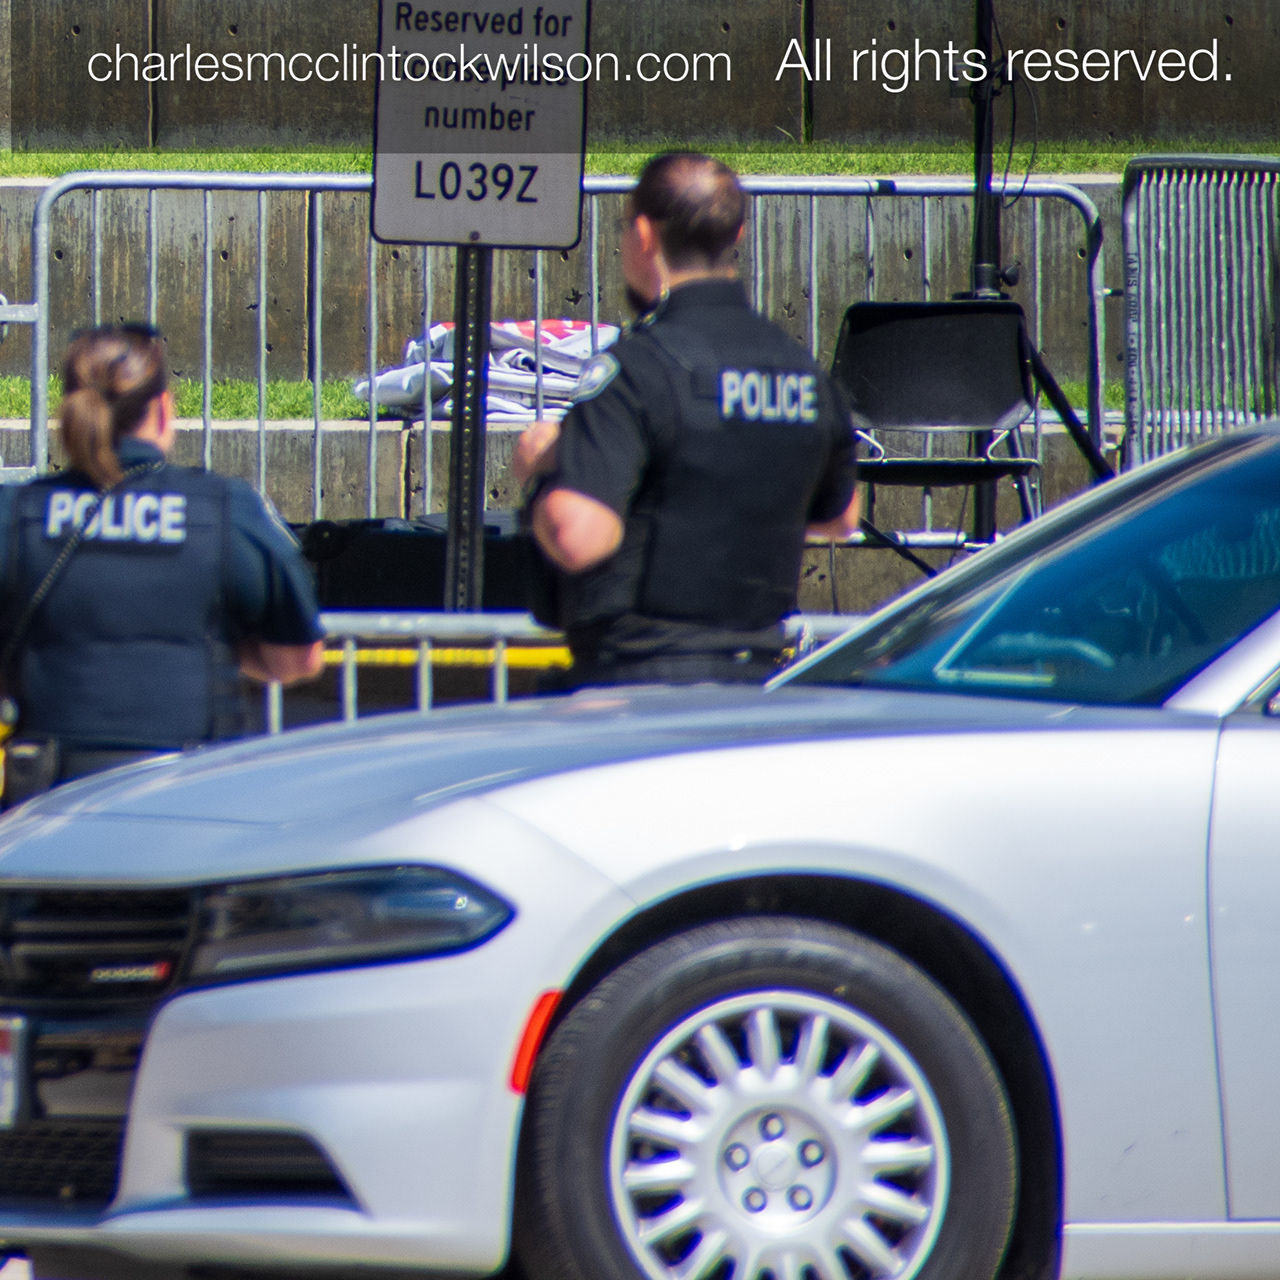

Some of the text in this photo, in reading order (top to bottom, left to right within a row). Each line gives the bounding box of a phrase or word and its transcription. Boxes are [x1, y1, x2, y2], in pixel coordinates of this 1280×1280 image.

[395, 2, 572, 38] Reserved for
[424, 101, 535, 132] number
[721, 370, 819, 422] POLICE
[45, 492, 187, 543] POLICE
